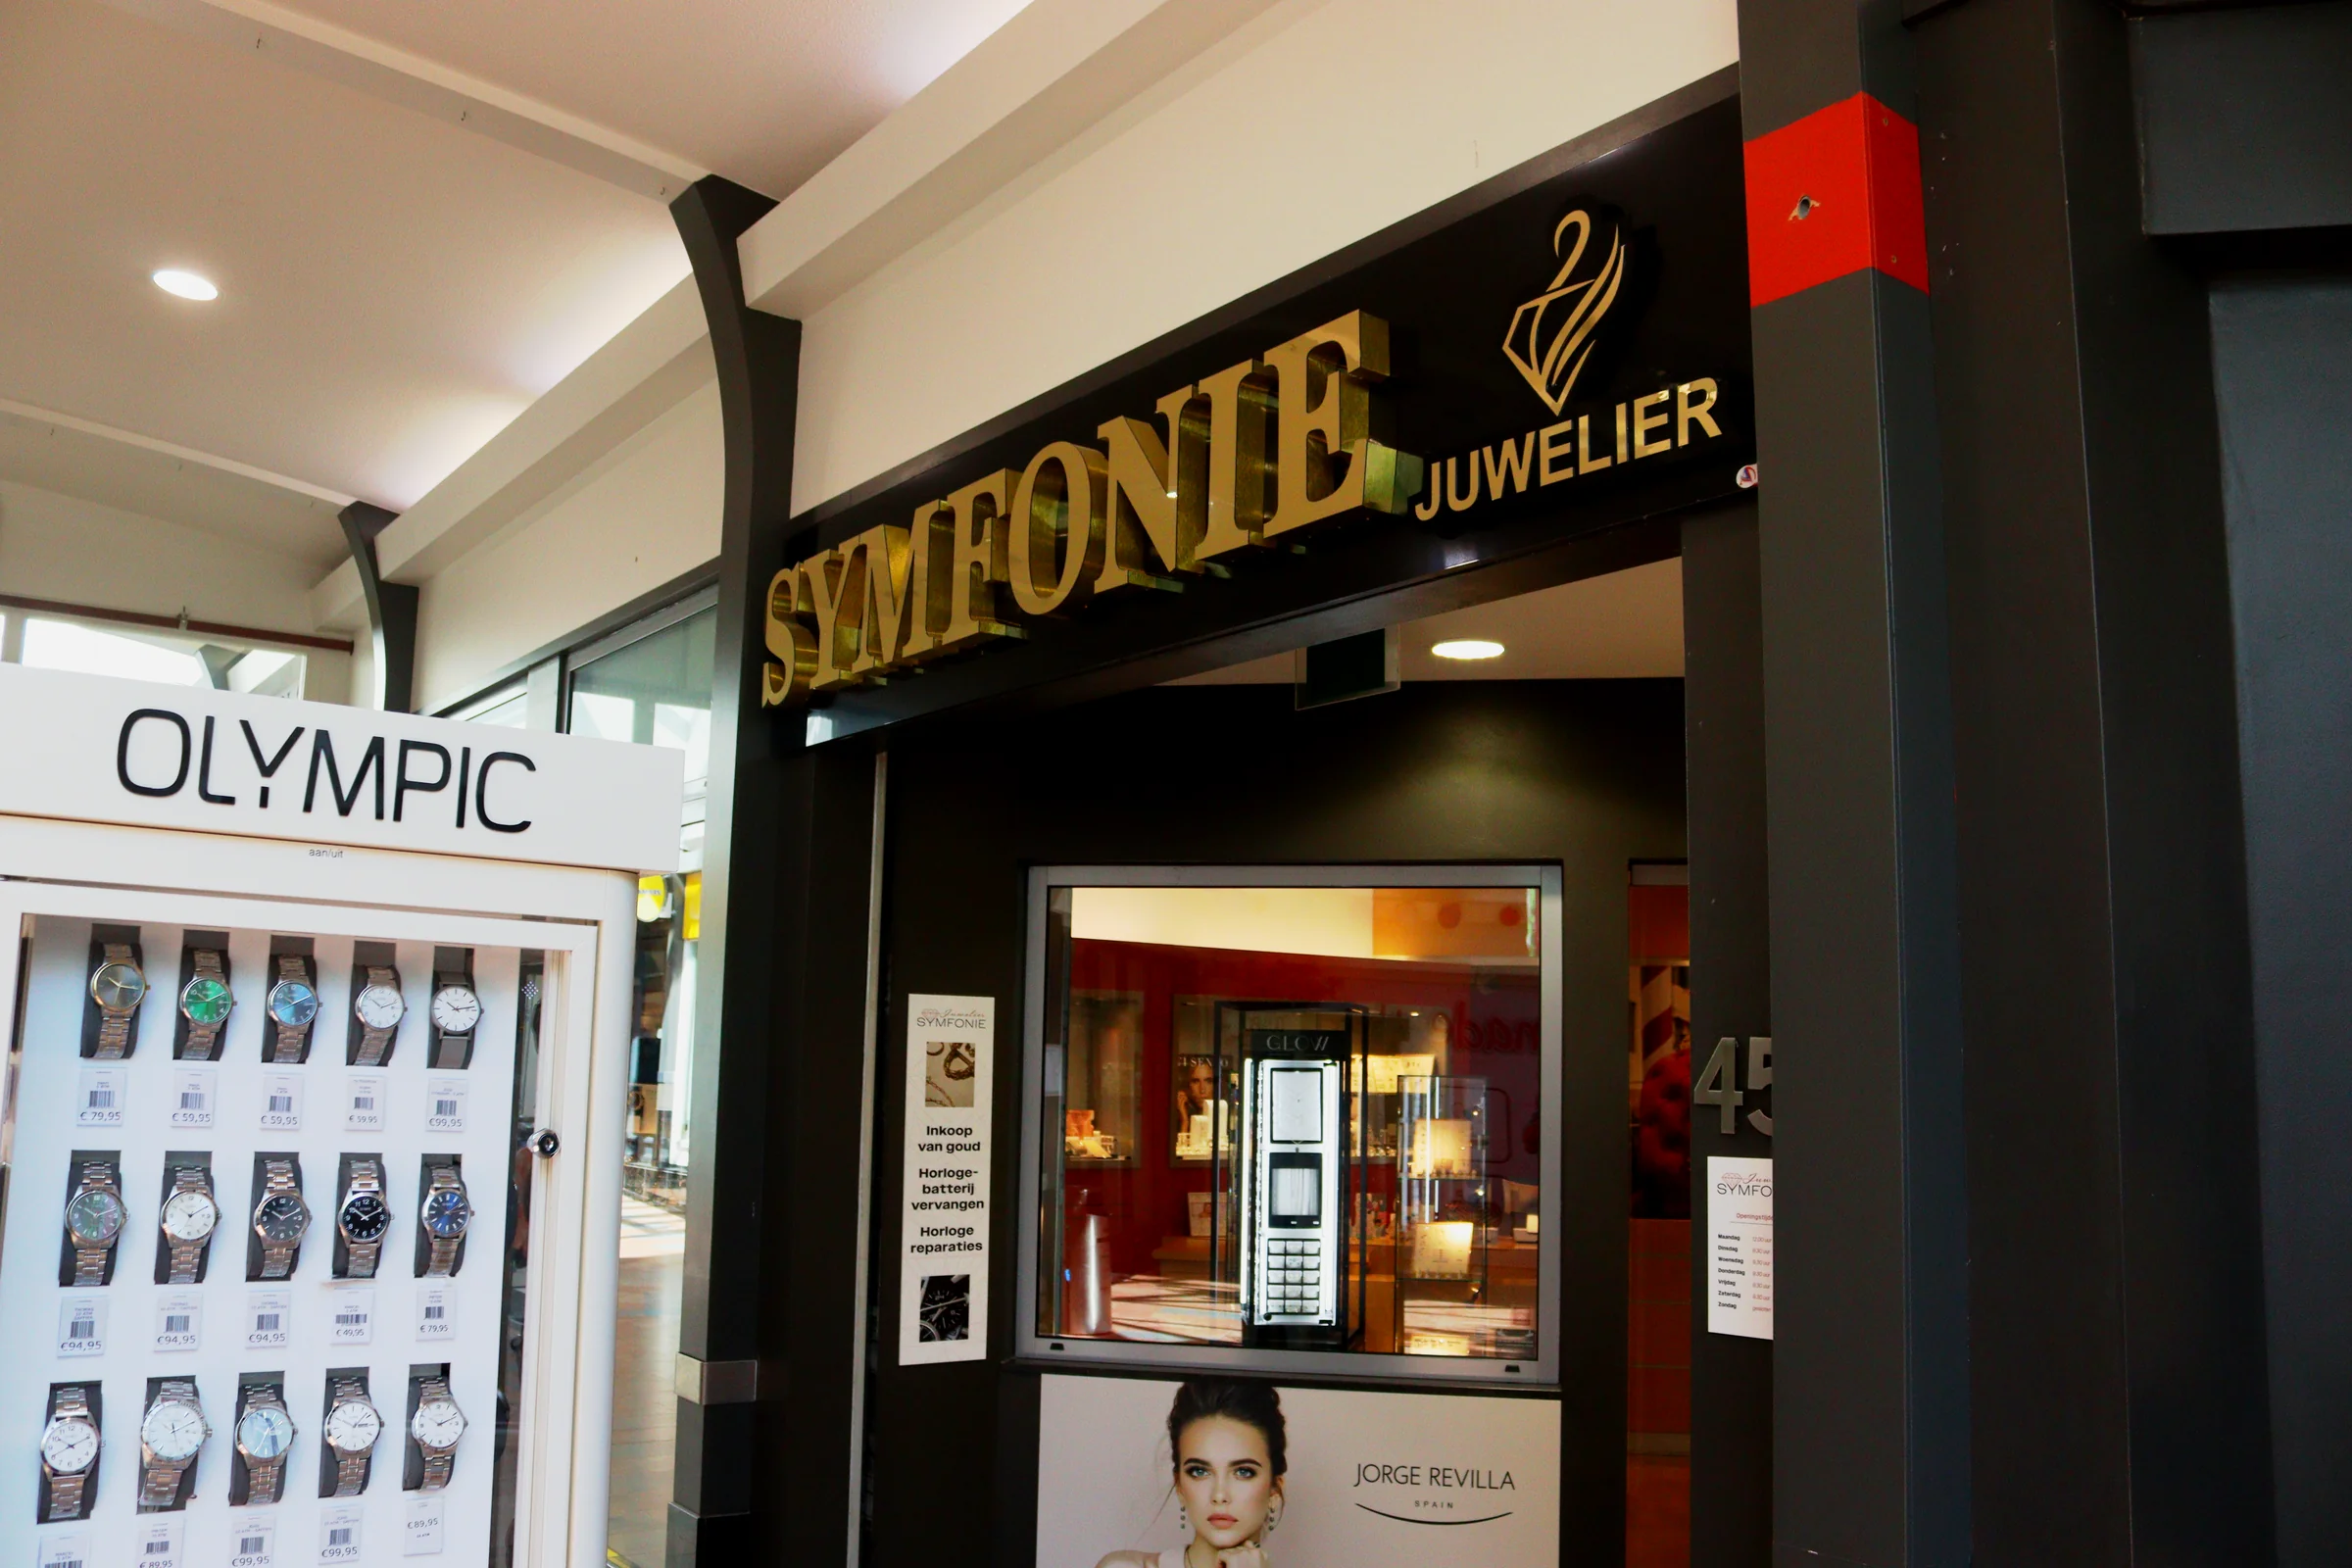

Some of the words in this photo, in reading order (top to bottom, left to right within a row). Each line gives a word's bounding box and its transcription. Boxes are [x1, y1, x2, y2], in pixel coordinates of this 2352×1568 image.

[1414, 376, 1722, 520] JUWELIER
[761, 309, 1384, 710] SYMFONIE
[117, 708, 536, 833] OLYMPIC
[309, 849, 343, 858] aan/uit
[916, 1017, 986, 1029] SYMFONIE
[1266, 1035, 1329, 1052] GLOW
[90, 1111, 122, 1123] 79,95
[182, 1113, 211, 1123] 59,95
[270, 1115, 298, 1126] 59,95
[926, 1125, 973, 1138] Inkoop
[918, 1143, 943, 1152] van
[946, 1142, 981, 1153] goud
[918, 1168, 978, 1180] Horloge-
[922, 1183, 974, 1196] batterij
[911, 1200, 984, 1211] vervangen
[920, 1226, 974, 1238] Horloge
[910, 1242, 983, 1254] reparaties
[1718, 1267, 1745, 1276] Donderdag
[1718, 1290, 1741, 1298] Zaterdag
[157, 1335, 196, 1346] €94,95
[249, 1333, 286, 1344] €94,95
[60, 1341, 102, 1351] €94,95
[1353, 1463, 1421, 1487] JORGE
[1429, 1467, 1515, 1491] REVILLA
[1414, 1500, 1454, 1509] SPAIN
[321, 1546, 358, 1558] €99,95
[231, 1555, 270, 1567] €99,95
